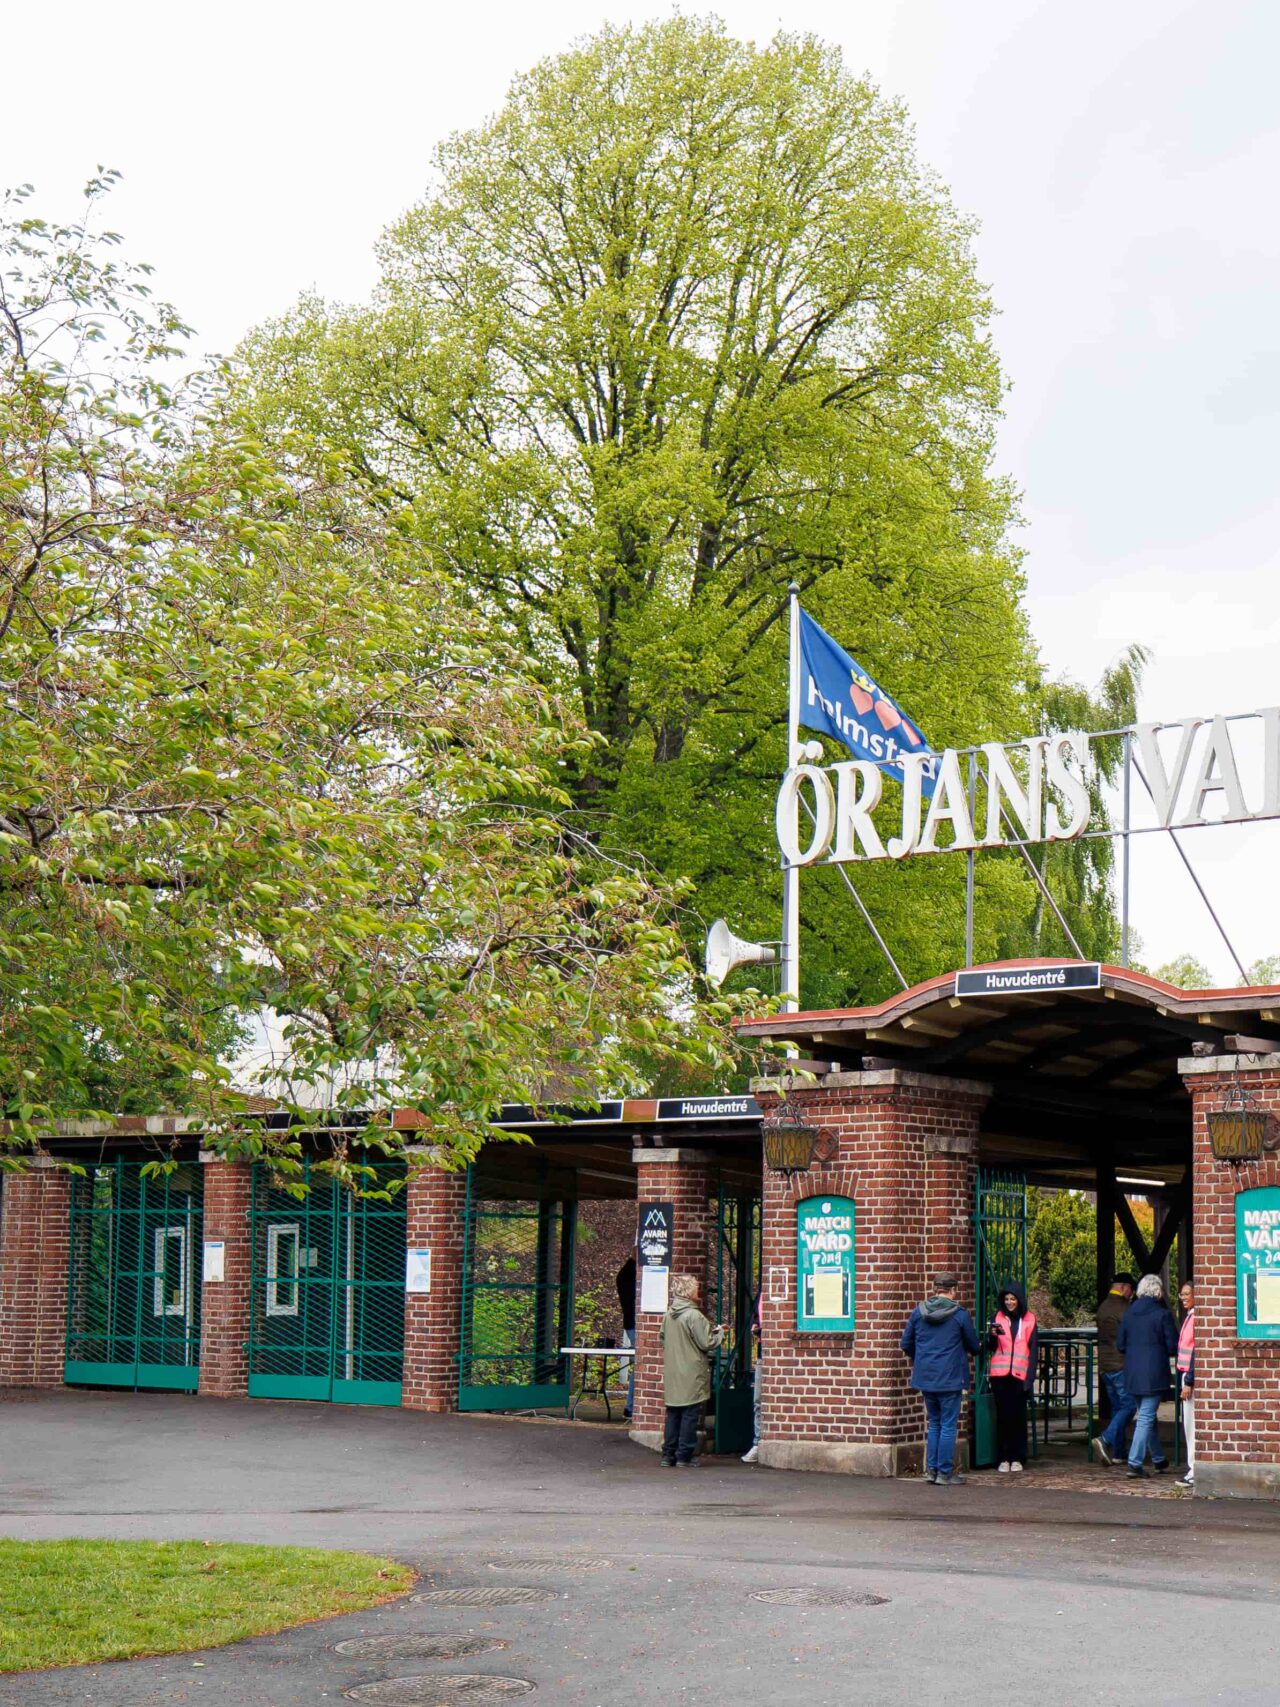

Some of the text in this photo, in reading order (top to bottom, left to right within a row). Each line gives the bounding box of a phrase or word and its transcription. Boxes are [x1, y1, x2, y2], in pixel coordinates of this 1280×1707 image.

[776, 732, 1091, 867] ÖRJANS
[986, 970, 1066, 988] Huvudentré
[681, 1099, 748, 1115] Huvudentré
[804, 1216, 851, 1231] MATCH
[643, 1230, 668, 1239] AVARN
